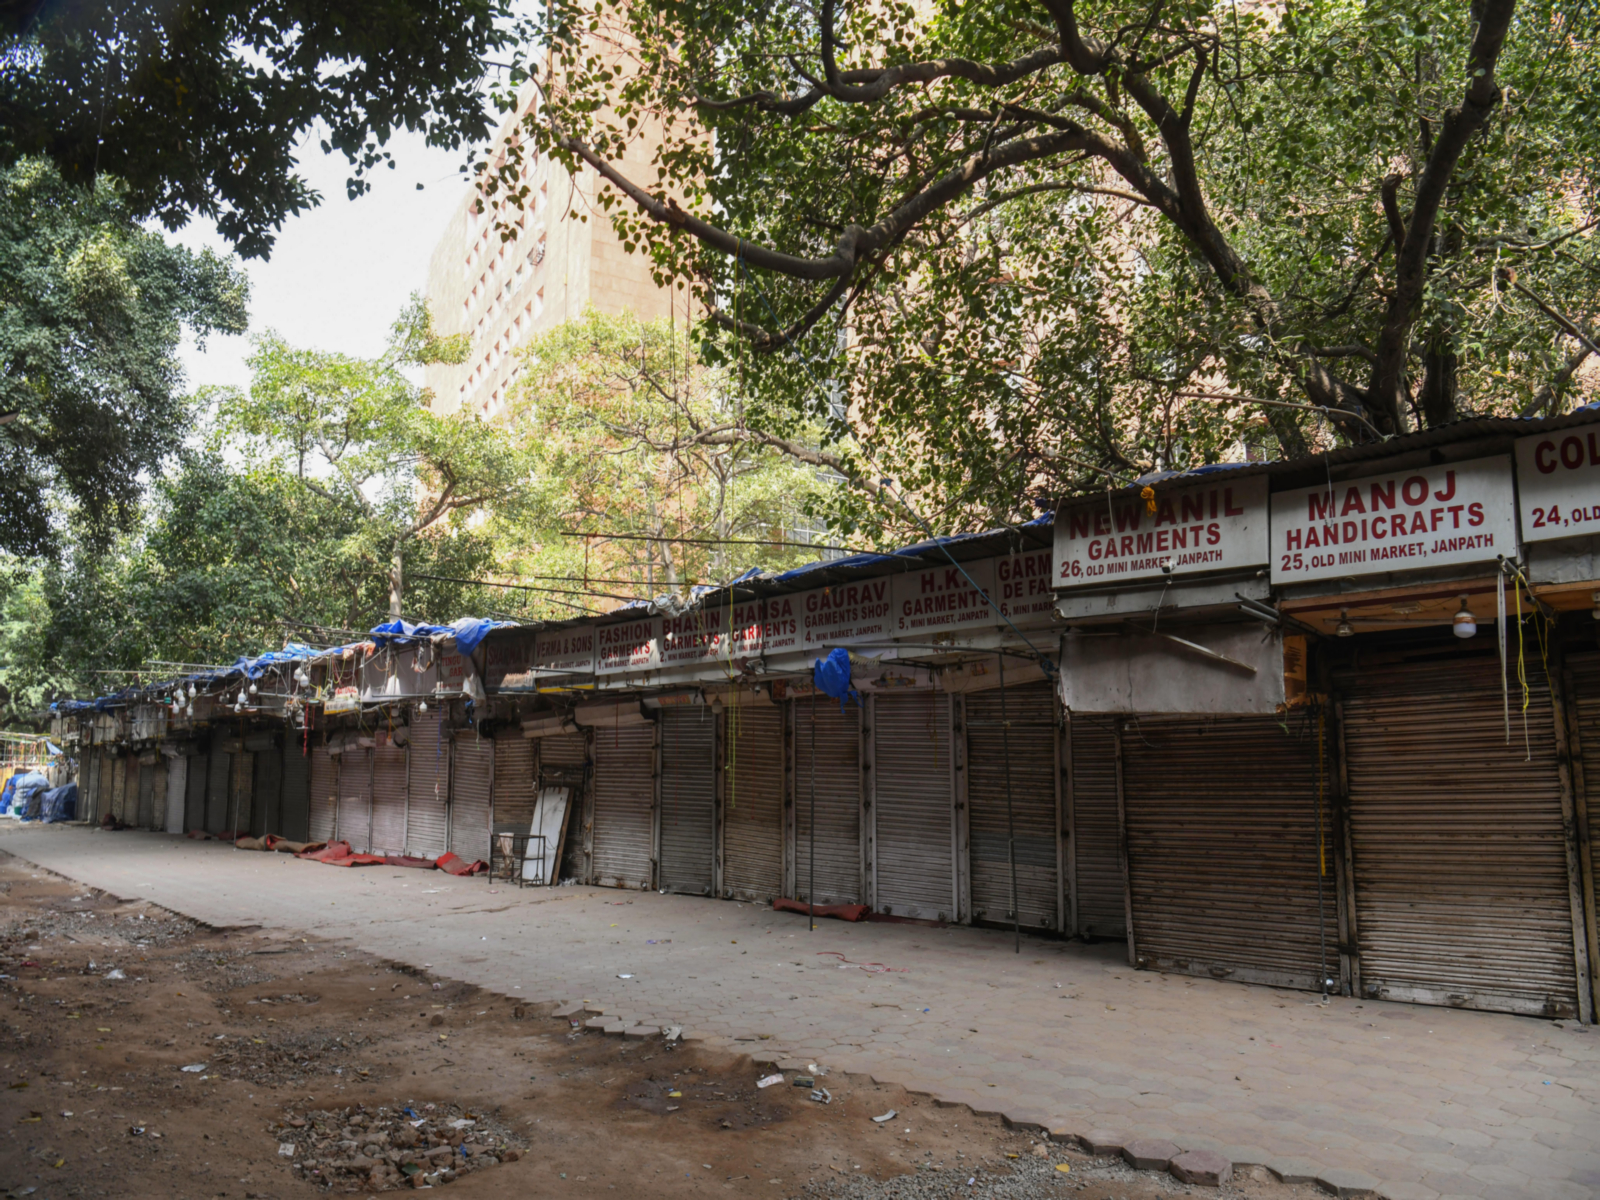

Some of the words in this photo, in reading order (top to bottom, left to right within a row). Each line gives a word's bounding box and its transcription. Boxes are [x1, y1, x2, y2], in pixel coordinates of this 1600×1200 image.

[1308, 470, 1456, 521] MANOJ
[1069, 502, 1142, 540] NEW
[1154, 487, 1244, 527] ANIL
[1532, 505, 1569, 528] 24,
[1571, 505, 1600, 523] OLD
[1286, 502, 1485, 551] HANDICRAFTS
[1088, 522, 1221, 561] GARMENTS
[1281, 553, 1309, 571] 25,
[1311, 554, 1335, 568] OLD
[1339, 550, 1366, 565] MINI
[1370, 542, 1427, 561] MARKET,
[1431, 533, 1494, 553] JANPATH
[1060, 560, 1084, 579] 26,
[1086, 564, 1104, 576] OLD
[1107, 561, 1128, 574] MINI
[1176, 549, 1223, 565] JANPATH
[921, 568, 968, 593] H.K.
[1003, 581, 1023, 599] DE
[806, 581, 886, 612] GAURAV
[903, 588, 990, 616] GARMENTS
[733, 599, 793, 625] HANSA
[804, 607, 858, 628] GARMENTS
[861, 602, 889, 620] SHOP
[899, 617, 909, 630] 5,
[911, 618, 925, 628] MINI
[927, 614, 956, 626] MARKET,
[957, 609, 989, 622] JANPATH
[1000, 602, 1011, 618] 6,
[1013, 604, 1030, 615] MINI
[599, 622, 652, 645] FASHION
[662, 611, 721, 635] BHASIN
[732, 618, 796, 643] GARMENTS
[805, 630, 814, 643] 4,
[816, 632, 828, 641] MINI
[829, 628, 854, 639] MARKET,
[855, 624, 882, 636] JANPATH
[536, 639, 561, 658] VERMA
[564, 638, 569, 654] &
[571, 635, 593, 653] SONS
[600, 640, 651, 660] GARMENTS
[663, 630, 720, 651] GARMENTS
[772, 637, 795, 648] JANPATH
[605, 661, 613, 669] MINI
[631, 657, 649, 666] JANPATH
[660, 651, 667, 663] 2,
[668, 653, 677, 661] MINI
[678, 650, 697, 659] MARKET,
